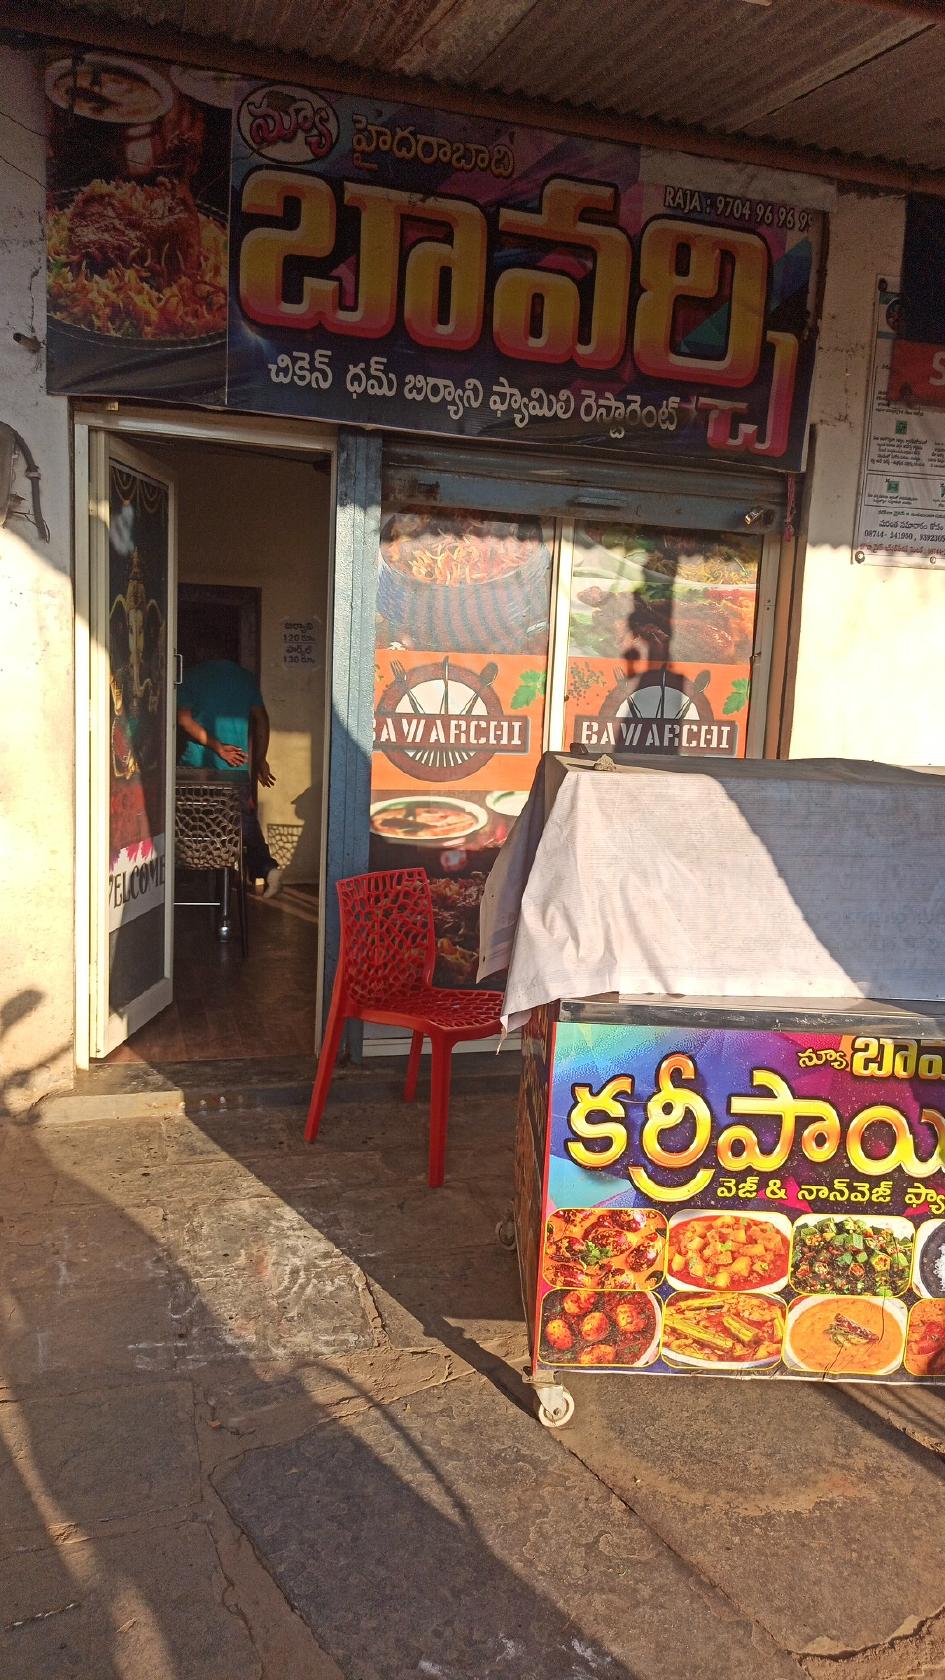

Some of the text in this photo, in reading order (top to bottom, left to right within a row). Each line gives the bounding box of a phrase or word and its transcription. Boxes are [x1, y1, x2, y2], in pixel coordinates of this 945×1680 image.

[664, 185, 701, 213] RAJA
[716, 195, 751, 221] 9704
[755, 202, 773, 226] 96
[778, 206, 795, 229] 96
[238, 169, 800, 457] బావర్చి
[267, 350, 333, 389] చికెన్
[404, 373, 484, 420] బిర్యాని
[581, 721, 730, 748] BAWARCHI
[797, 1048, 849, 1070] న్యూ
[716, 1176, 759, 1199] వెజ్
[765, 1179, 788, 1200] &
